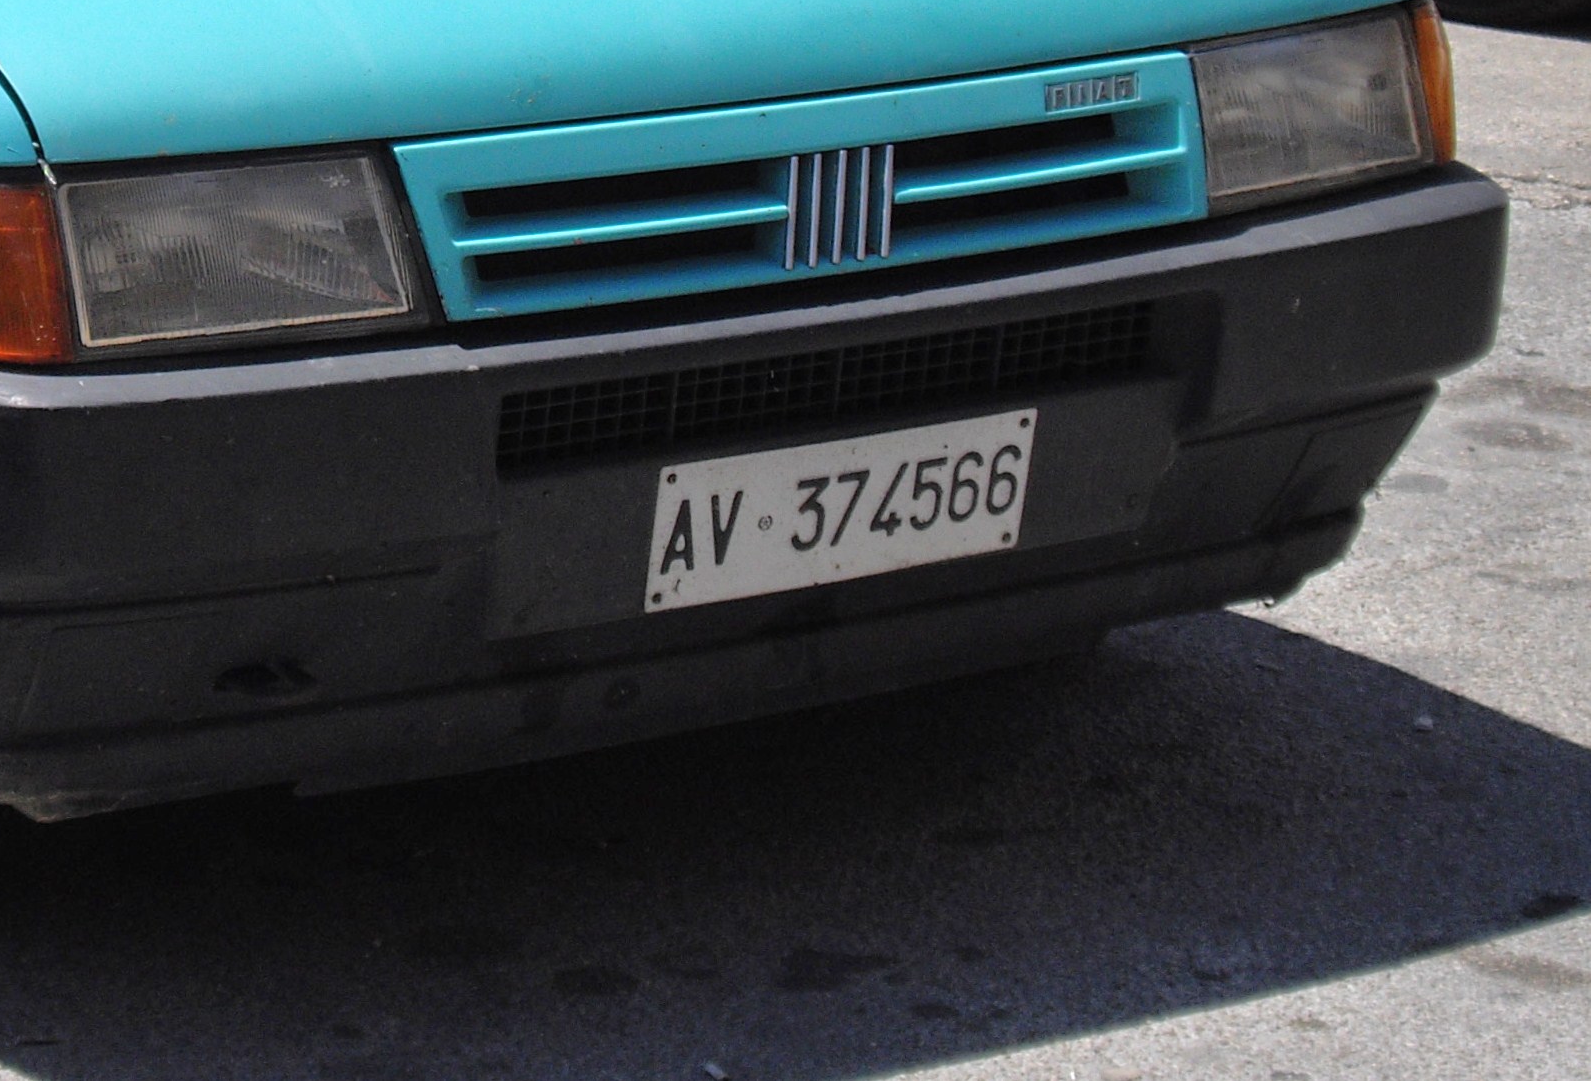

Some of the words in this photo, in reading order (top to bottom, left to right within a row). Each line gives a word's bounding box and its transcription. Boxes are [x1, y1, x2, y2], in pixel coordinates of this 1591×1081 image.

[1051, 76, 1133, 110] FIAT
[659, 490, 744, 575] AV
[790, 444, 1023, 553] 374566
